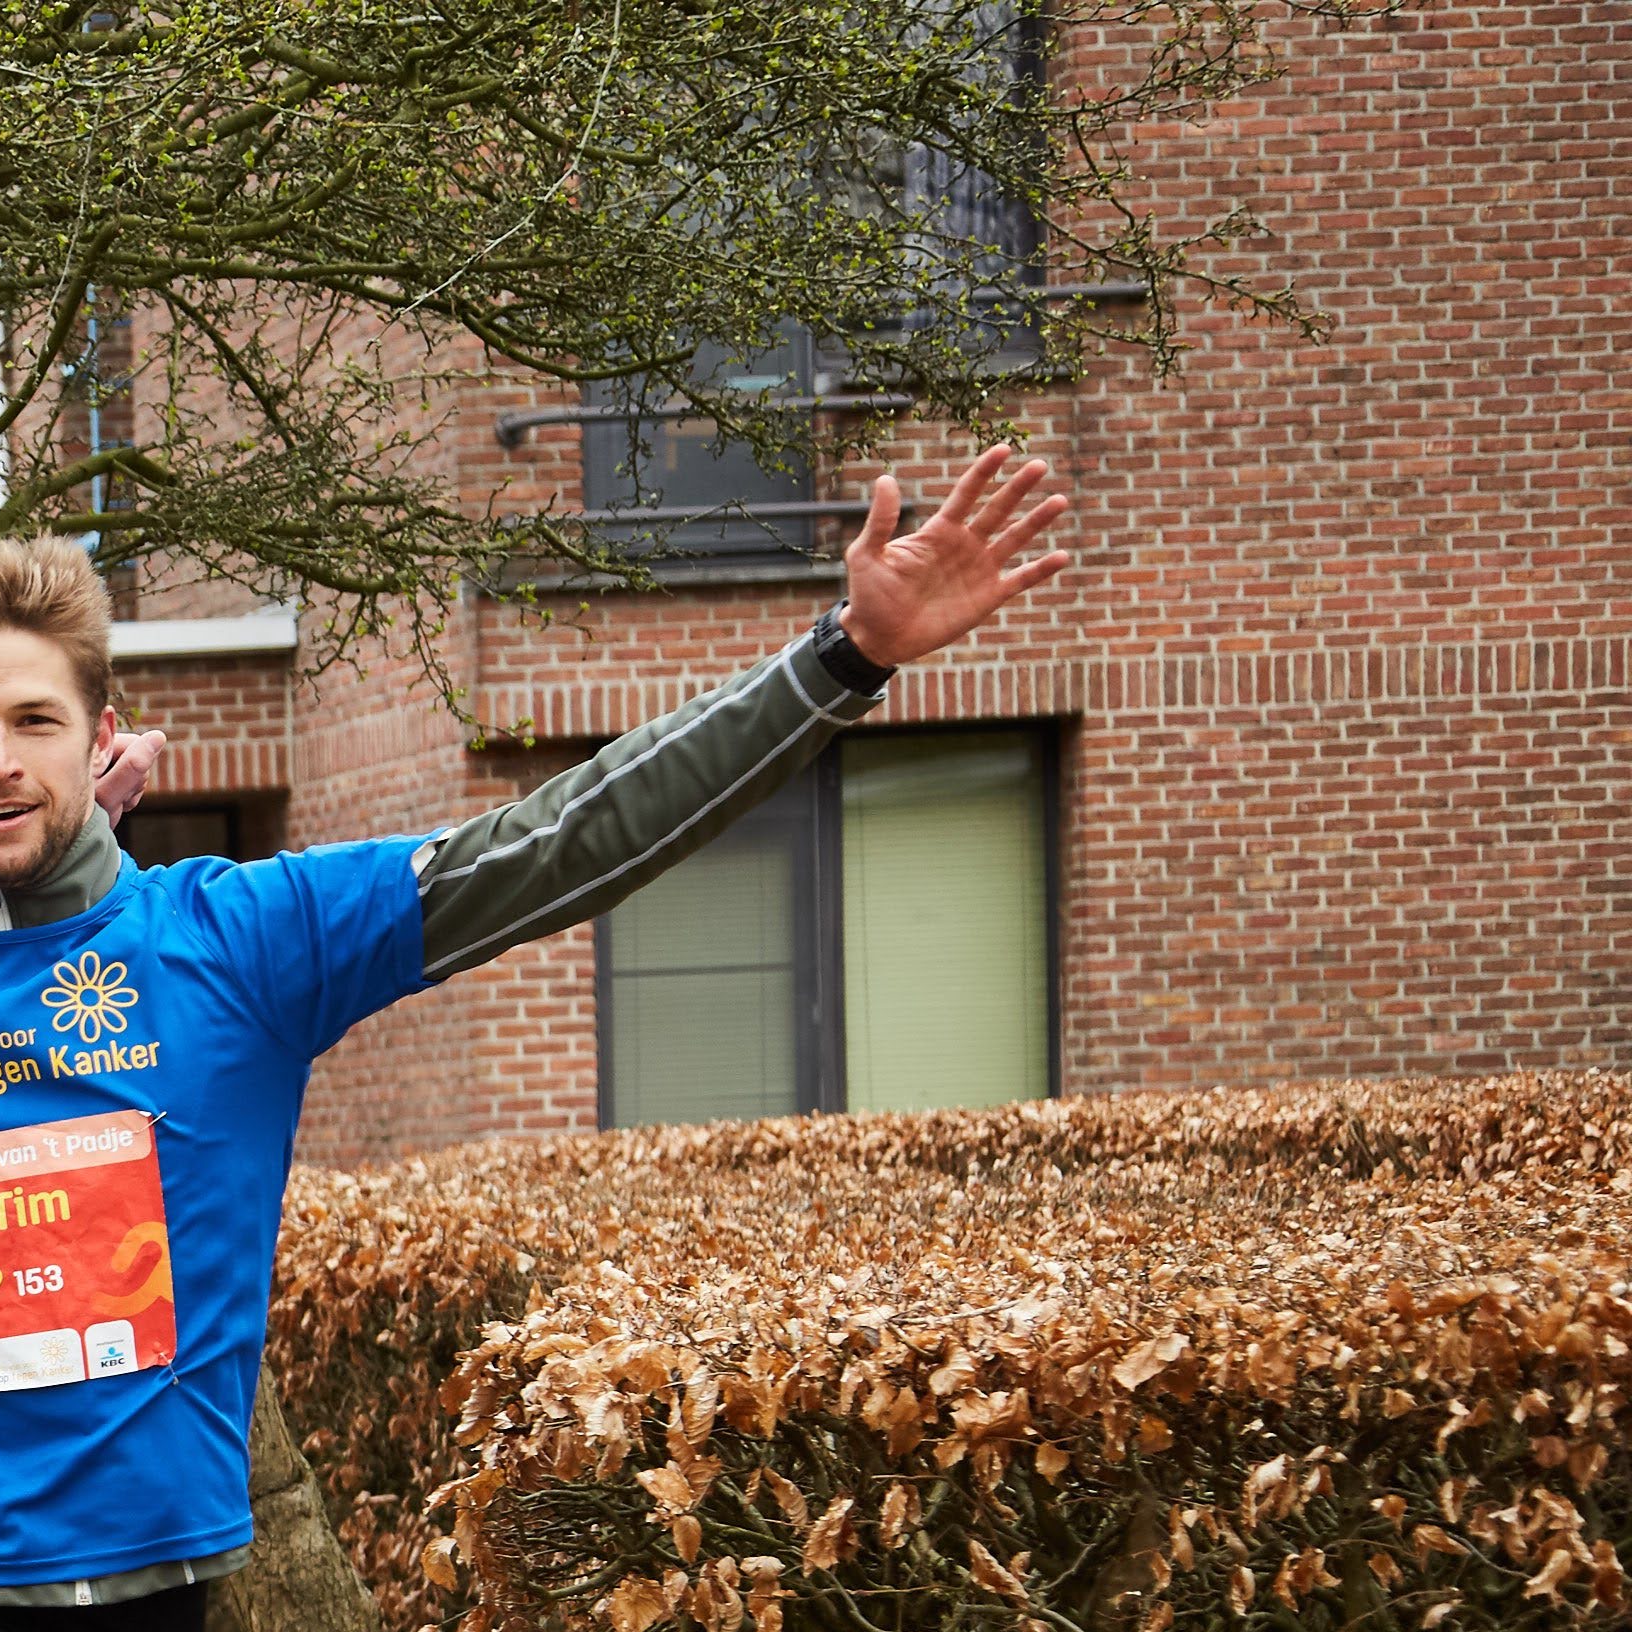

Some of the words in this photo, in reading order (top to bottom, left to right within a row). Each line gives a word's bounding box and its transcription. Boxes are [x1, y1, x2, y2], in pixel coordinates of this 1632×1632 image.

[47, 1039, 161, 1080] Kanker
[65, 1126, 134, 1156] Padje
[12, 1264, 65, 1297] 153
[100, 1356, 126, 1369] KBC
